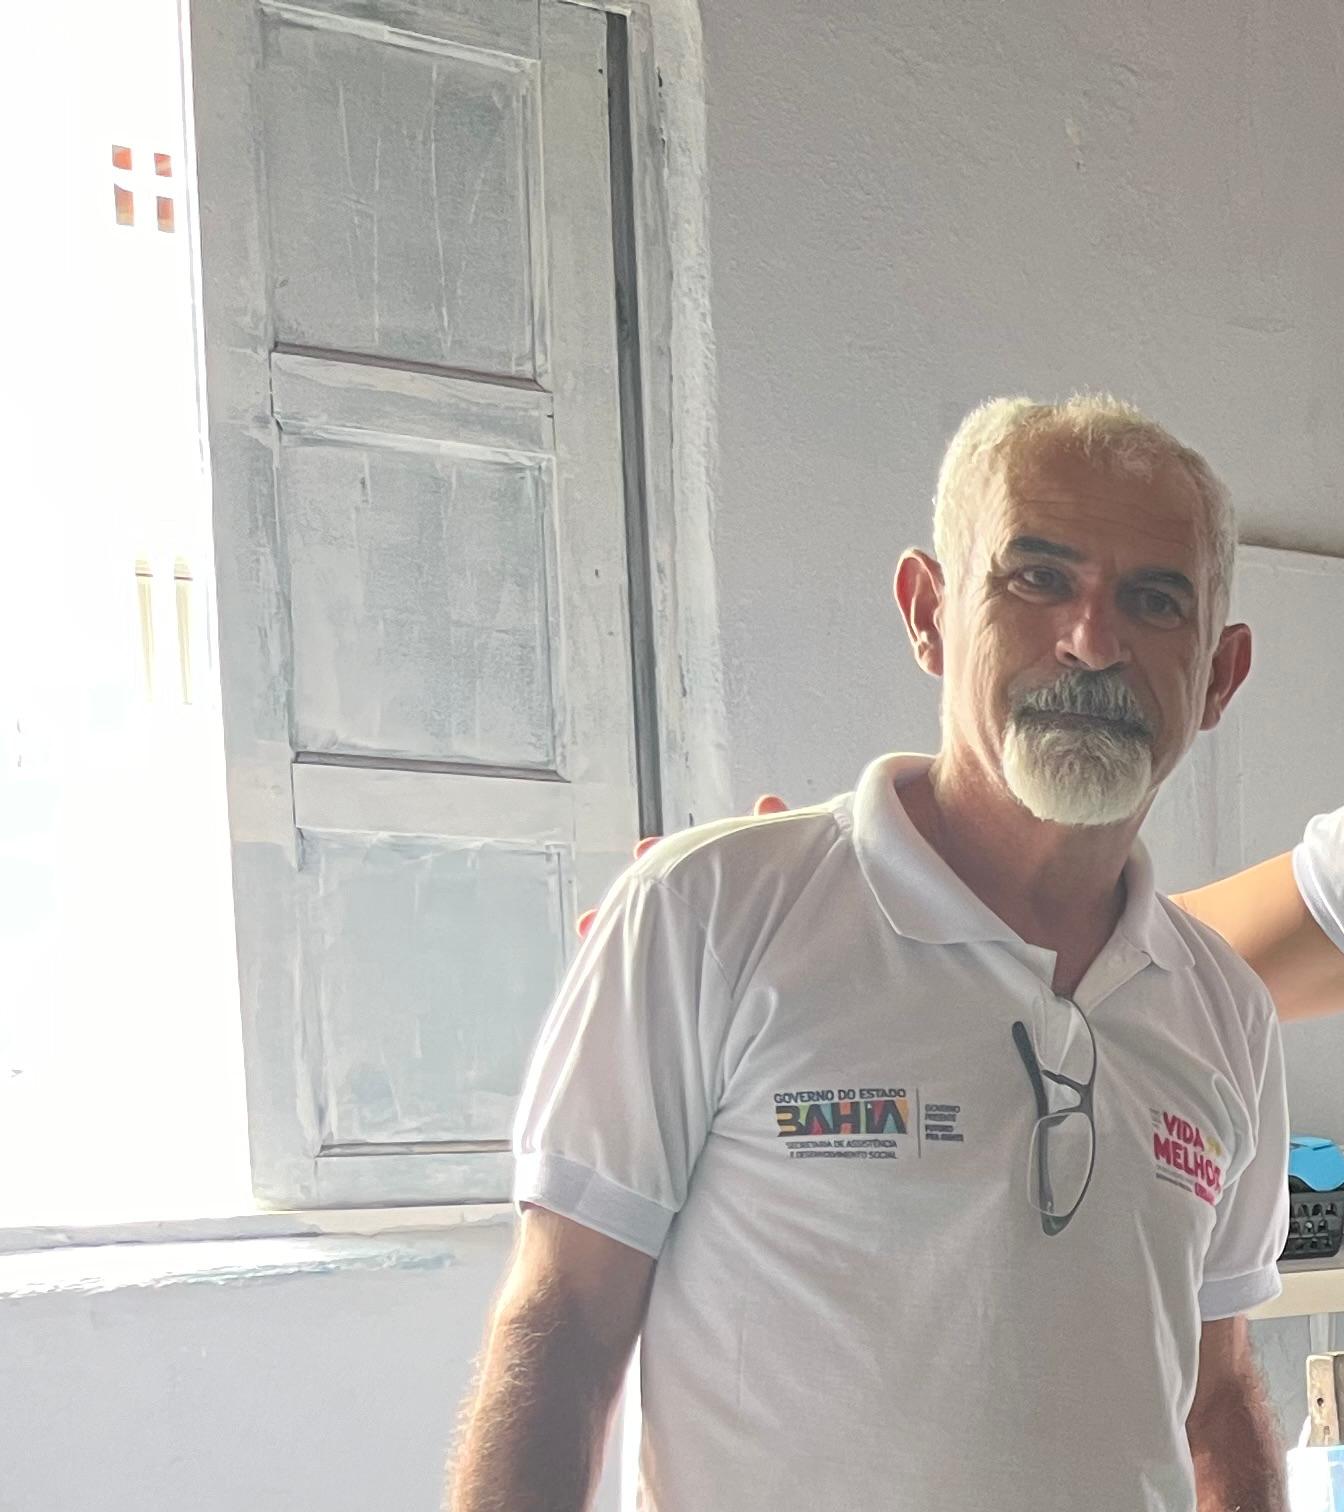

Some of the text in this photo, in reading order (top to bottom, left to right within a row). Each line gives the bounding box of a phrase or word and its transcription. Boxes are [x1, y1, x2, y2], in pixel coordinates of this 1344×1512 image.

[774, 1088, 906, 1104] GOVERNO DO ESTADO
[776, 1100, 907, 1137] BAHIA
[1163, 1111, 1205, 1152] VIDA
